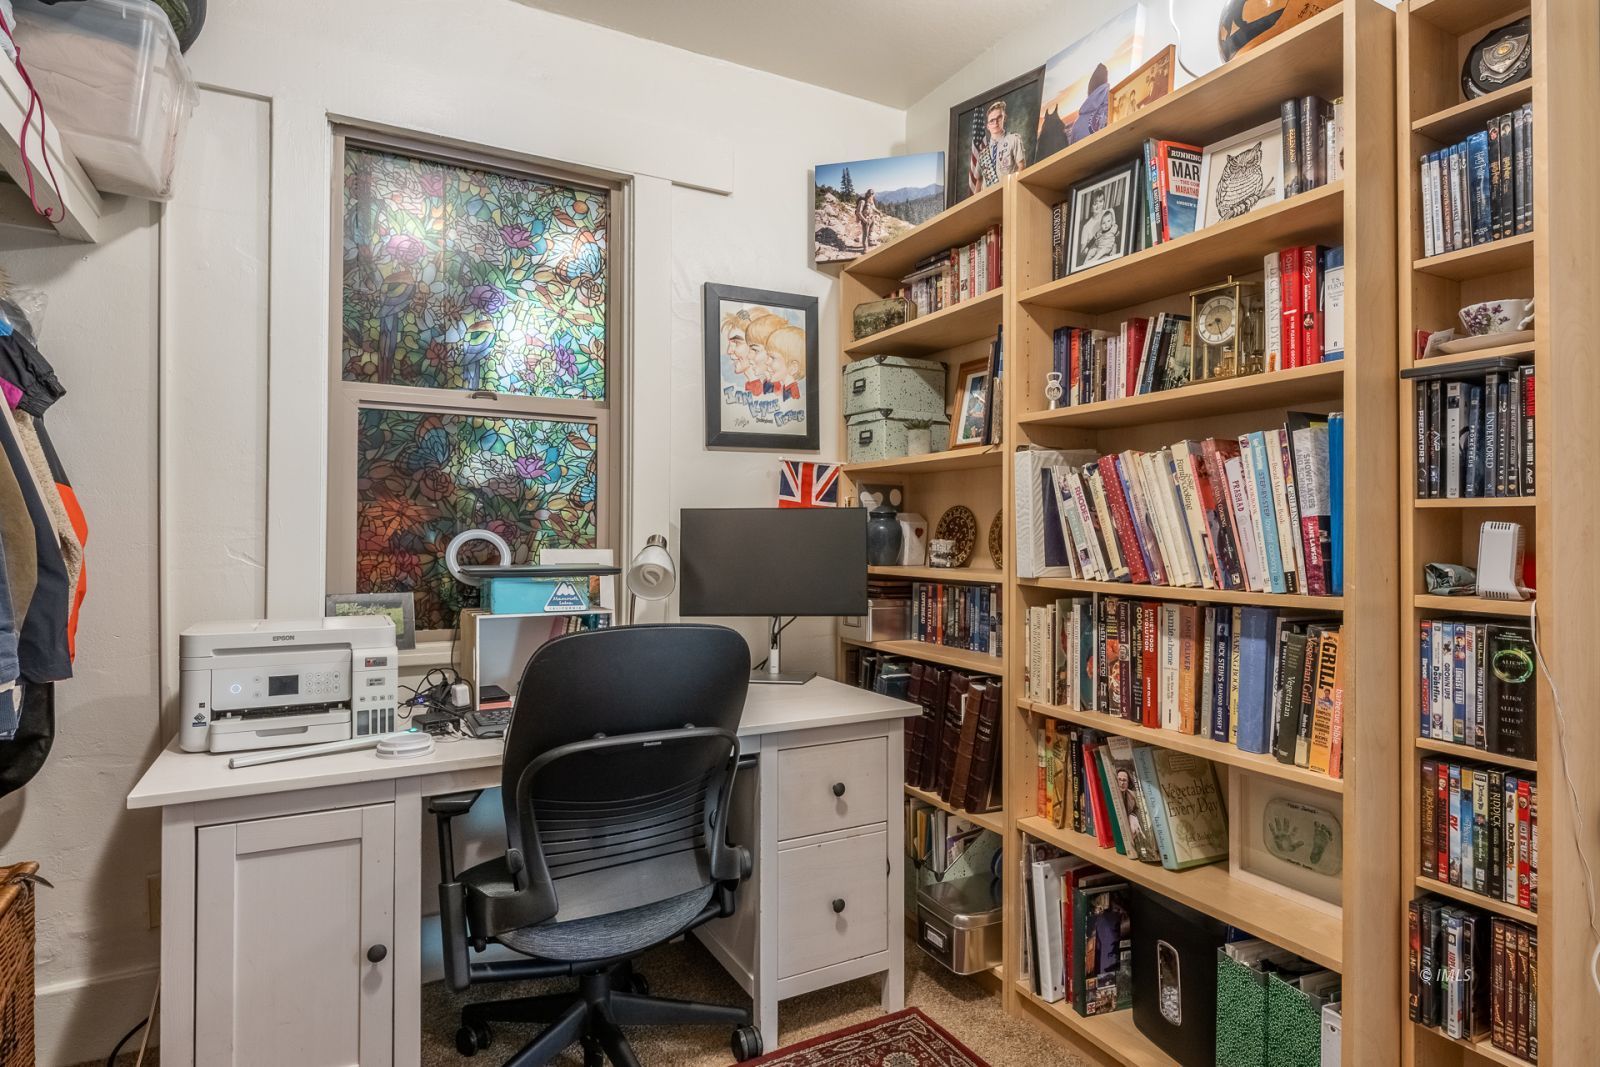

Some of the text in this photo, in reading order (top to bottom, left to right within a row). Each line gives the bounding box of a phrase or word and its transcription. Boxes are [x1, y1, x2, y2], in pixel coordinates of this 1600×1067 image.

[1171, 161, 1201, 182] MAR
[1053, 208, 1061, 246] CORNWELL
[1270, 267, 1279, 294] DICK
[1270, 299, 1279, 321] VAN
[1467, 425, 1476, 468] PROMETHEUS
[1486, 412, 1496, 469] UNDERWORLD
[1176, 459, 1194, 511] Family Cooking
[1271, 463, 1280, 480] Bread
[1296, 448, 1309, 510] AND SCHNAPPS
[1302, 454, 1316, 509] SNOWFLAKES
[1074, 486, 1090, 523] RHODES
[1232, 480, 1244, 512] PRASHAD
[1258, 472, 1270, 517] STEP-BY-STEP
[1273, 481, 1282, 507] Machine
[1287, 485, 1299, 526] GRILLING
[1217, 503, 1227, 528] COOKING
[1277, 508, 1286, 525] Book
[1309, 538, 1318, 565] LAWSON
[1165, 608, 1176, 636] jamie
[1184, 616, 1192, 638] JAMIE
[1167, 643, 1176, 665] home
[1231, 632, 1240, 693] BAKING BOOK
[1319, 642, 1338, 689] GRILL
[1302, 636, 1318, 705] Vegetarian Grill
[1433, 666, 1441, 703] Doubtfire
[1455, 668, 1464, 690] LONGEST
[1284, 676, 1296, 717] Vegetarian
[1332, 689, 1343, 744] barbecue bible
[1161, 778, 1216, 804] Vegetables
[1168, 797, 1219, 821] Every Day
[1450, 815, 1458, 831] RV
[1493, 791, 1502, 828] RIDDICK
[1154, 816, 1165, 850] Jack Bishop
[1520, 839, 1528, 864] FUZZ
[1423, 945, 1431, 966] KING
